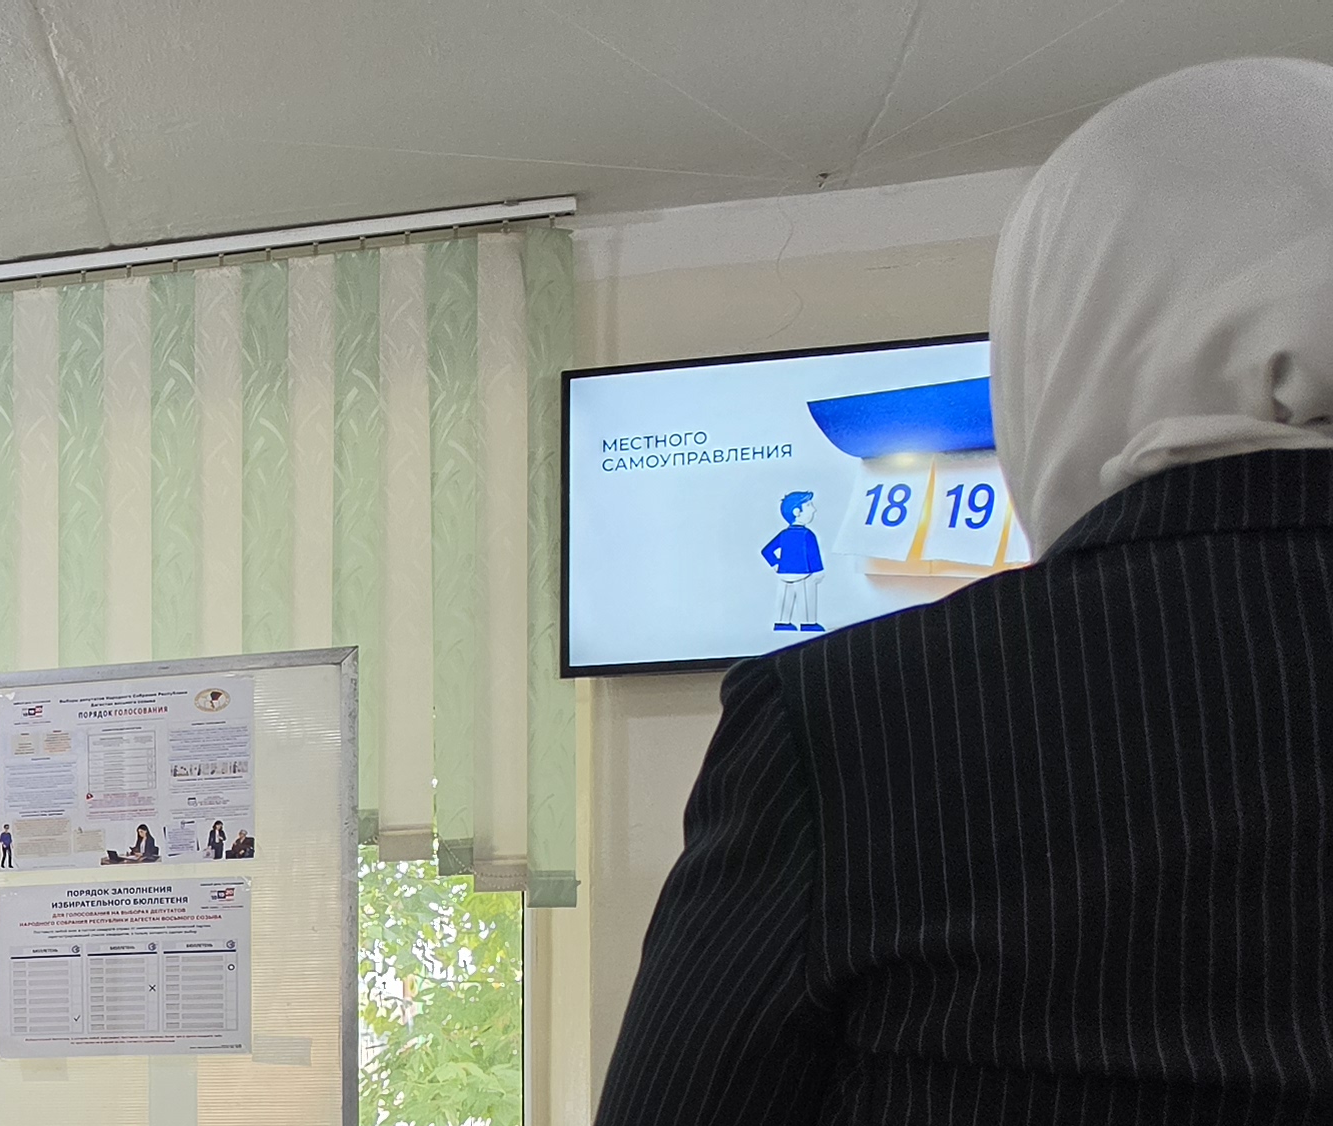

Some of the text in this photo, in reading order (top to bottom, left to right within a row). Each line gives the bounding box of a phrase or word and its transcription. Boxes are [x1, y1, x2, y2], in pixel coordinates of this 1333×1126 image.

[602, 431, 708, 453] МЕСТНОГО
[602, 443, 793, 472] САМОУПРАВЛЕНИЯ
[865, 483, 995, 529] 18 19
[78, 706, 168, 719] ПОРЯДОК ГОЛОСОВАНИЯ
[67, 886, 172, 897] ПОРЯДОК ЗАПОЛНЕНИЯ
[51, 897, 188, 909] ИЗБИРАТЕЛЬНОГО БЮЛЛЕТЕНЯ
